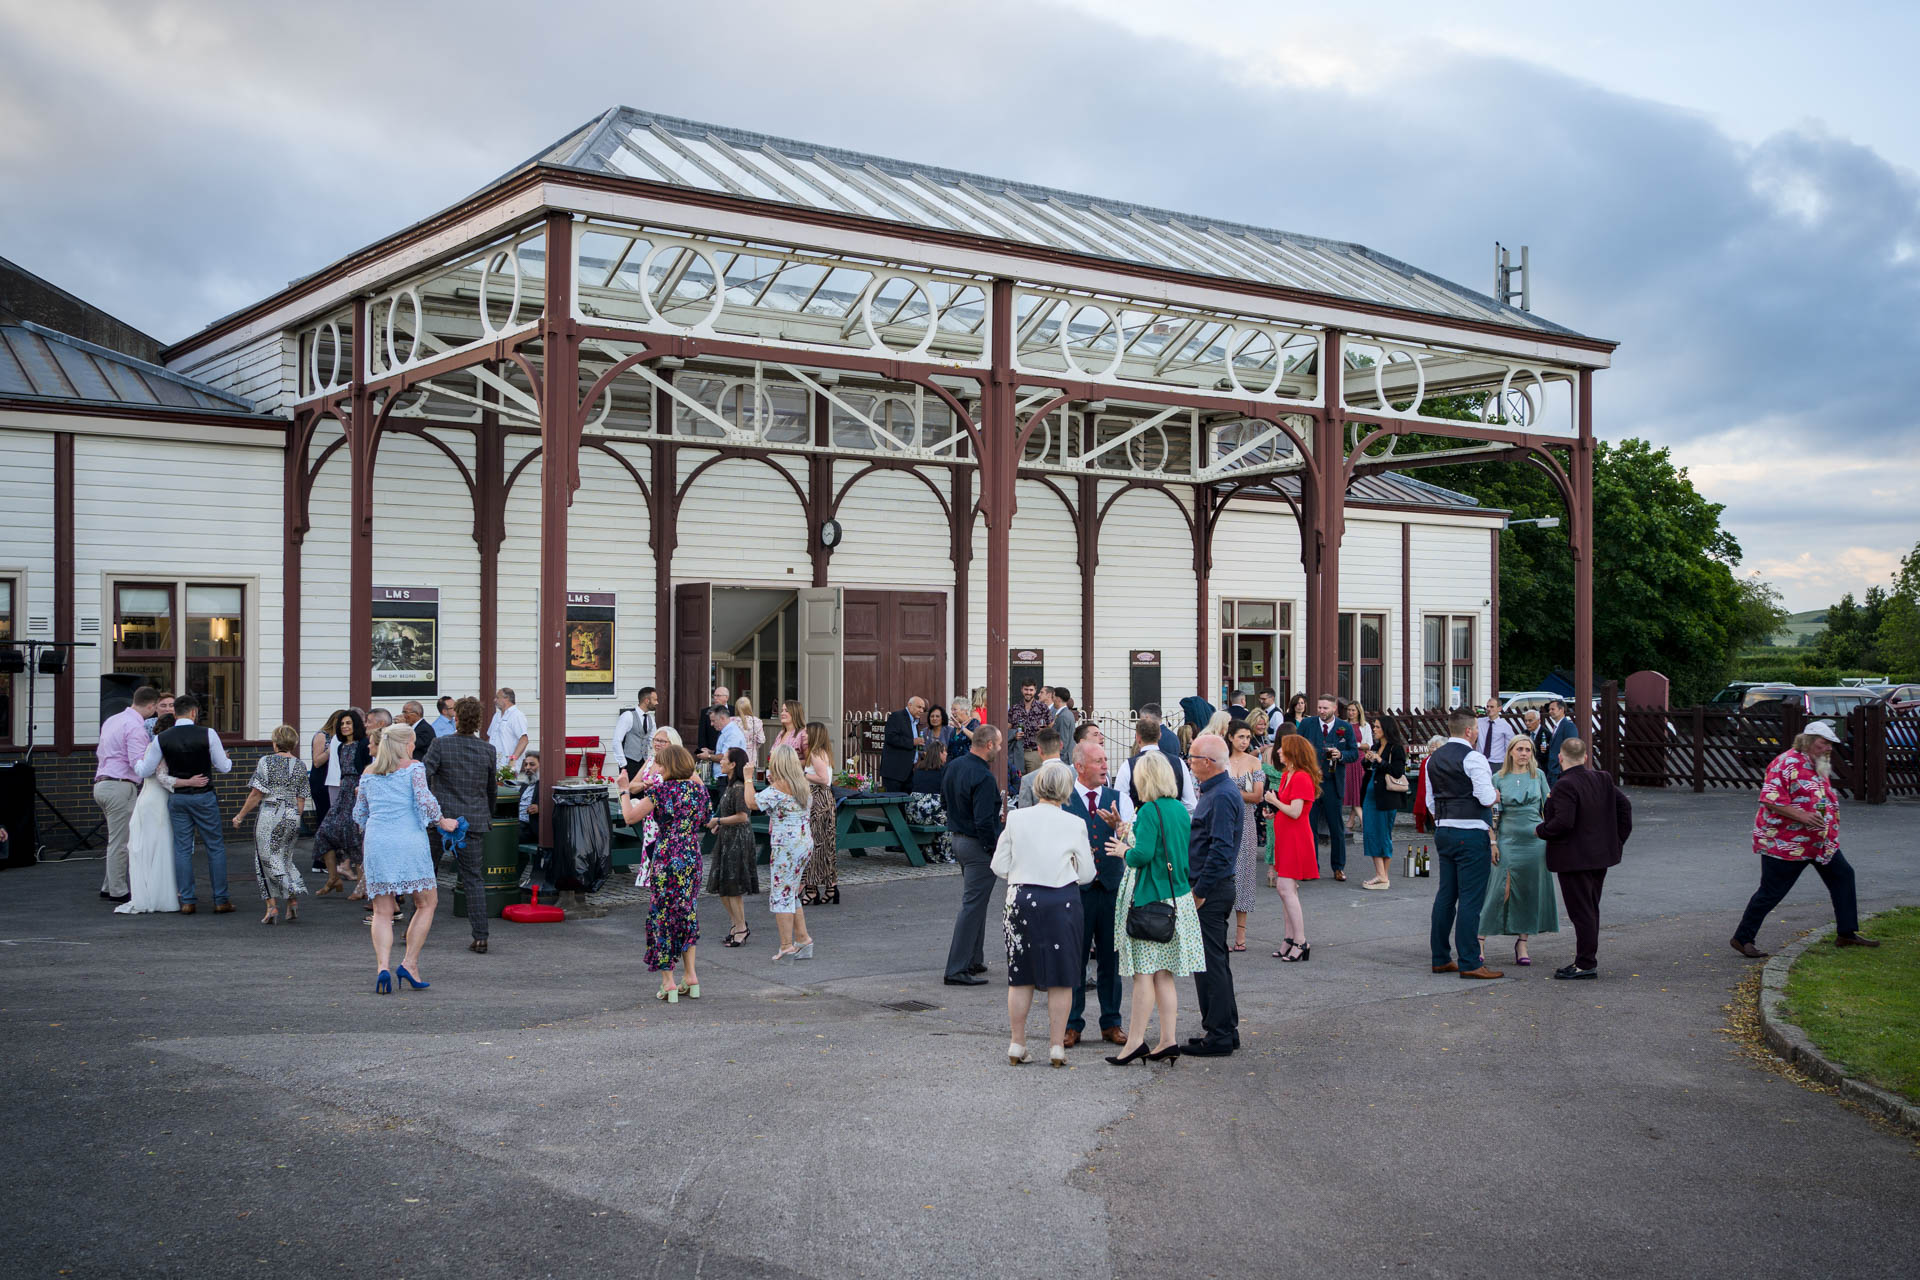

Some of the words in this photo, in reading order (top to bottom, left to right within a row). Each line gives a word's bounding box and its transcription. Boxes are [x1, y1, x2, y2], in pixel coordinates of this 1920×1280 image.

[385, 589, 411, 599] LMS
[568, 594, 591, 603] LMS
[871, 733, 880, 741] THE
[487, 866, 516, 875] LITTER
